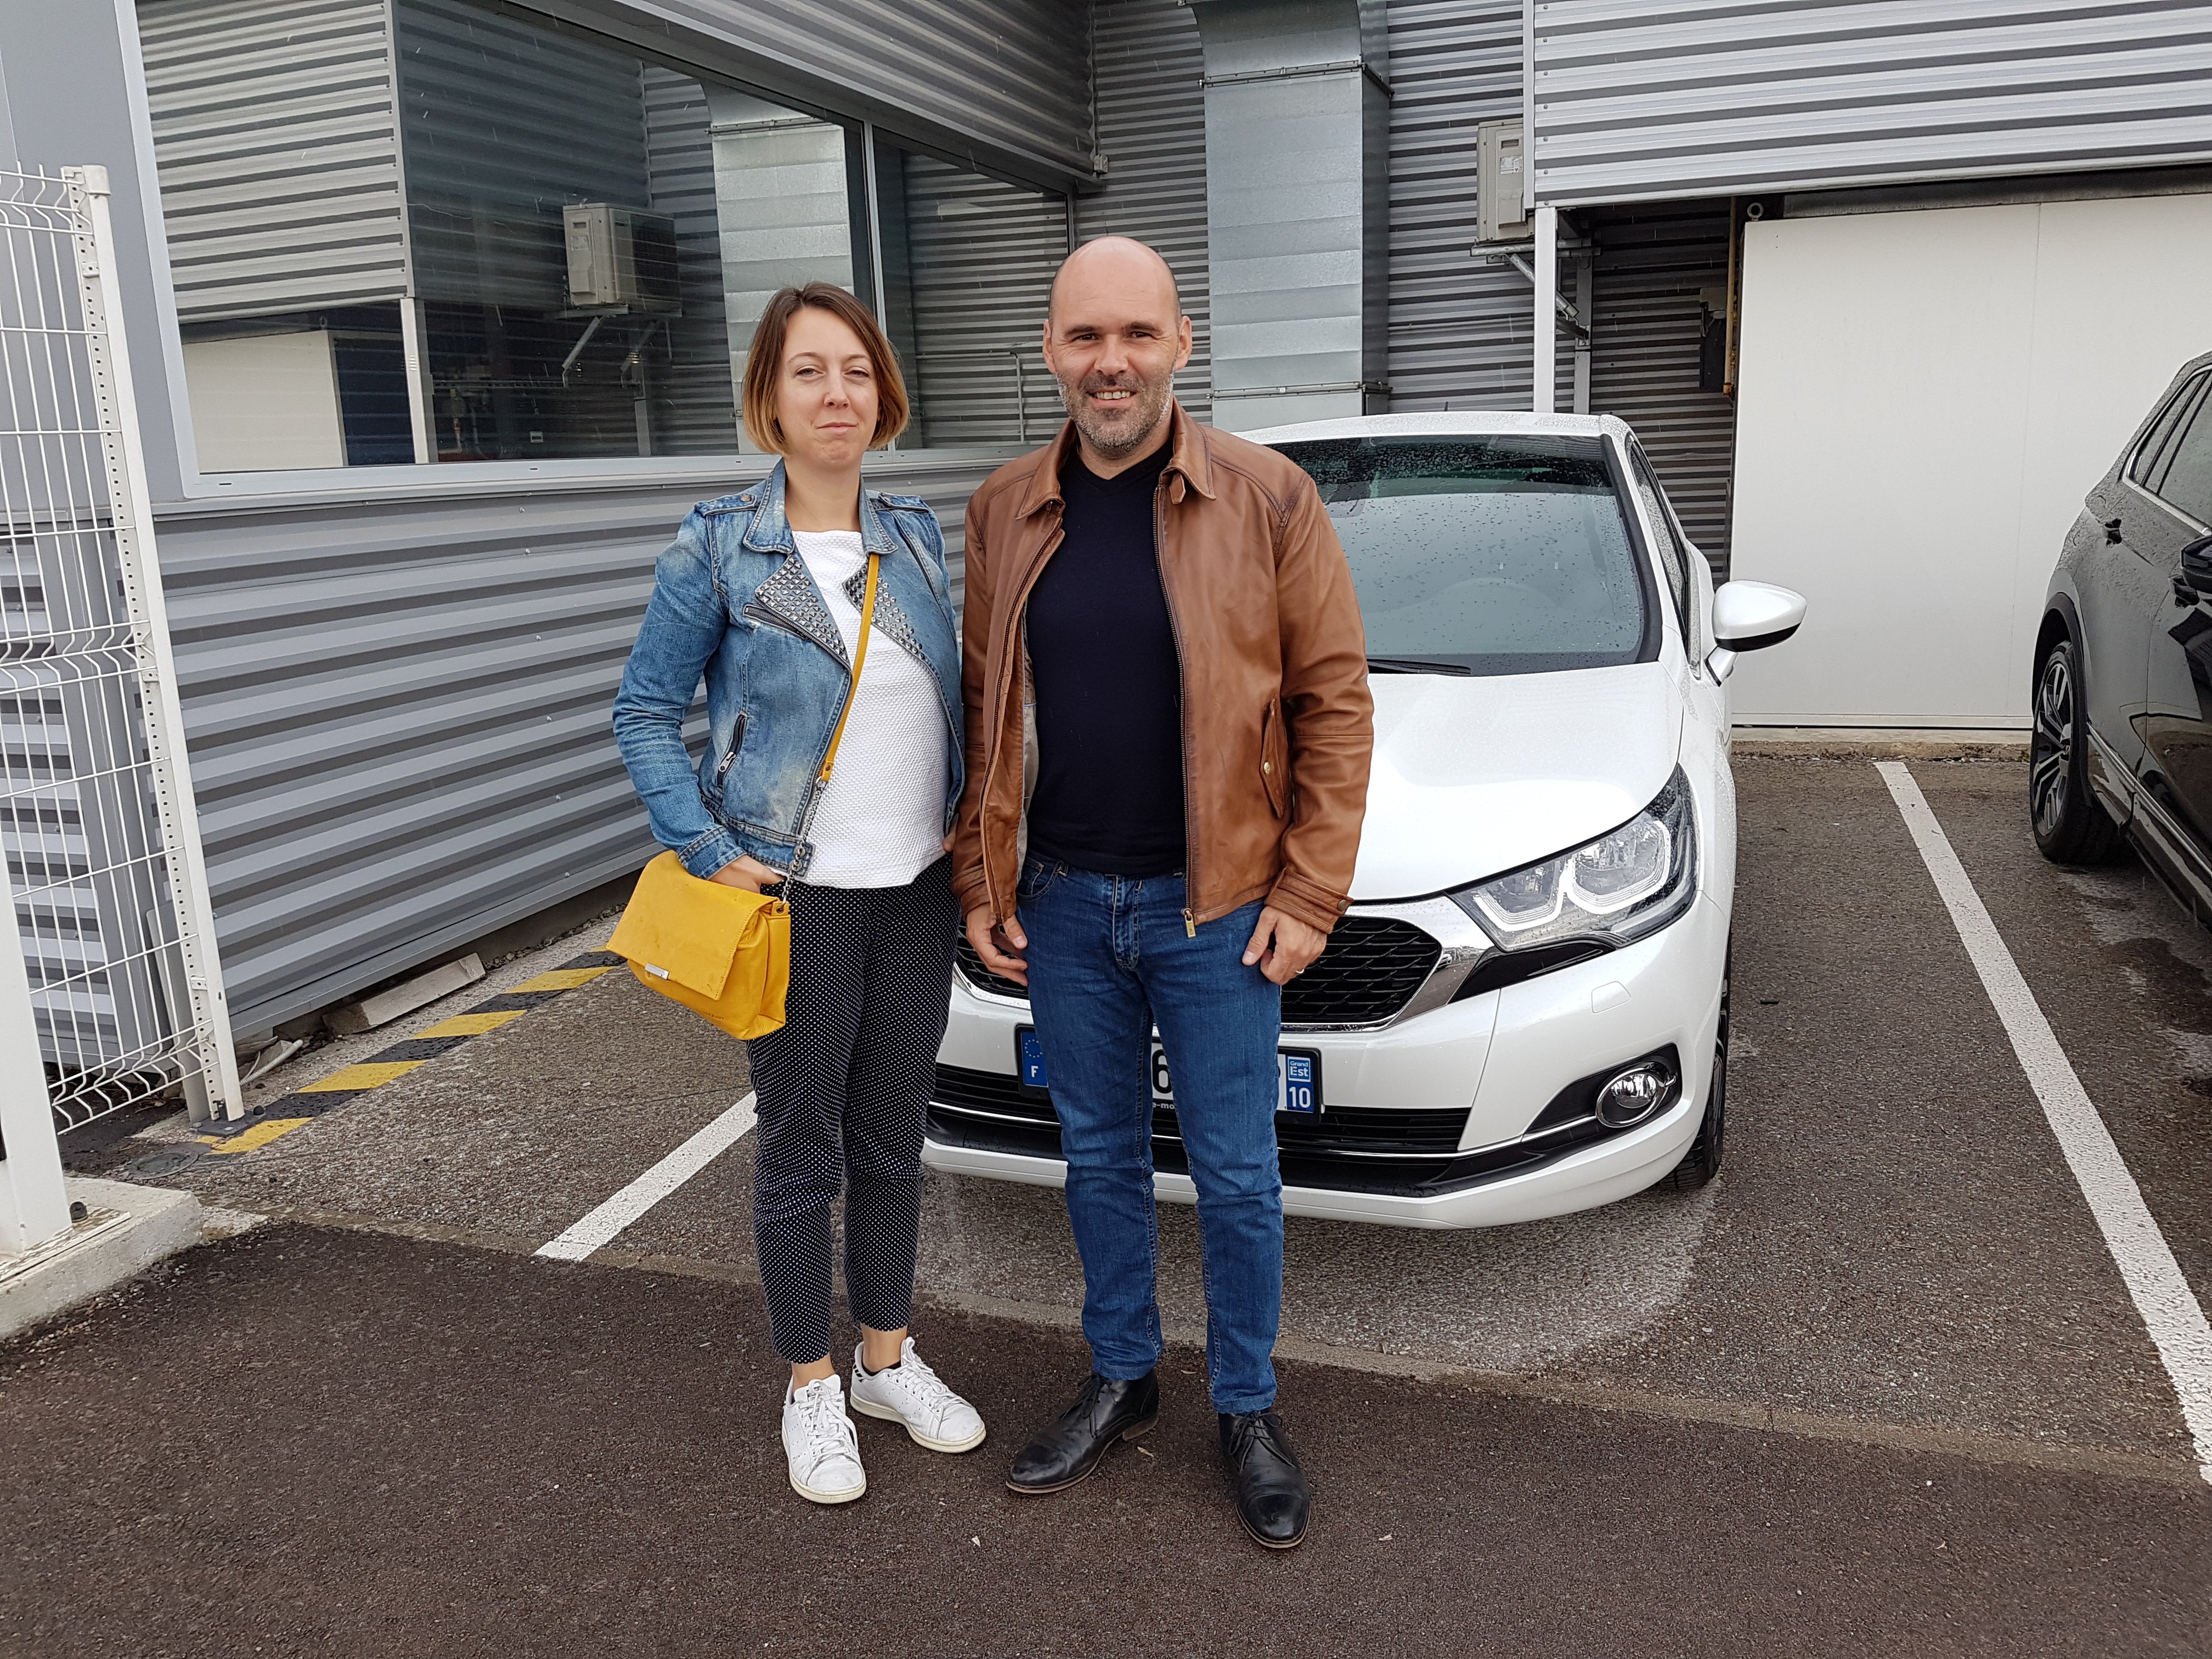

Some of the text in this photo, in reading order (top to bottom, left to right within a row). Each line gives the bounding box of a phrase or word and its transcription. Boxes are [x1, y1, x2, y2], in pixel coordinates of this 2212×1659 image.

[1031, 1065, 1039, 1077] F
[1153, 1049, 1172, 1094] 6
[1290, 1066, 1308, 1076] Est
[1289, 1086, 1311, 1108] 10
